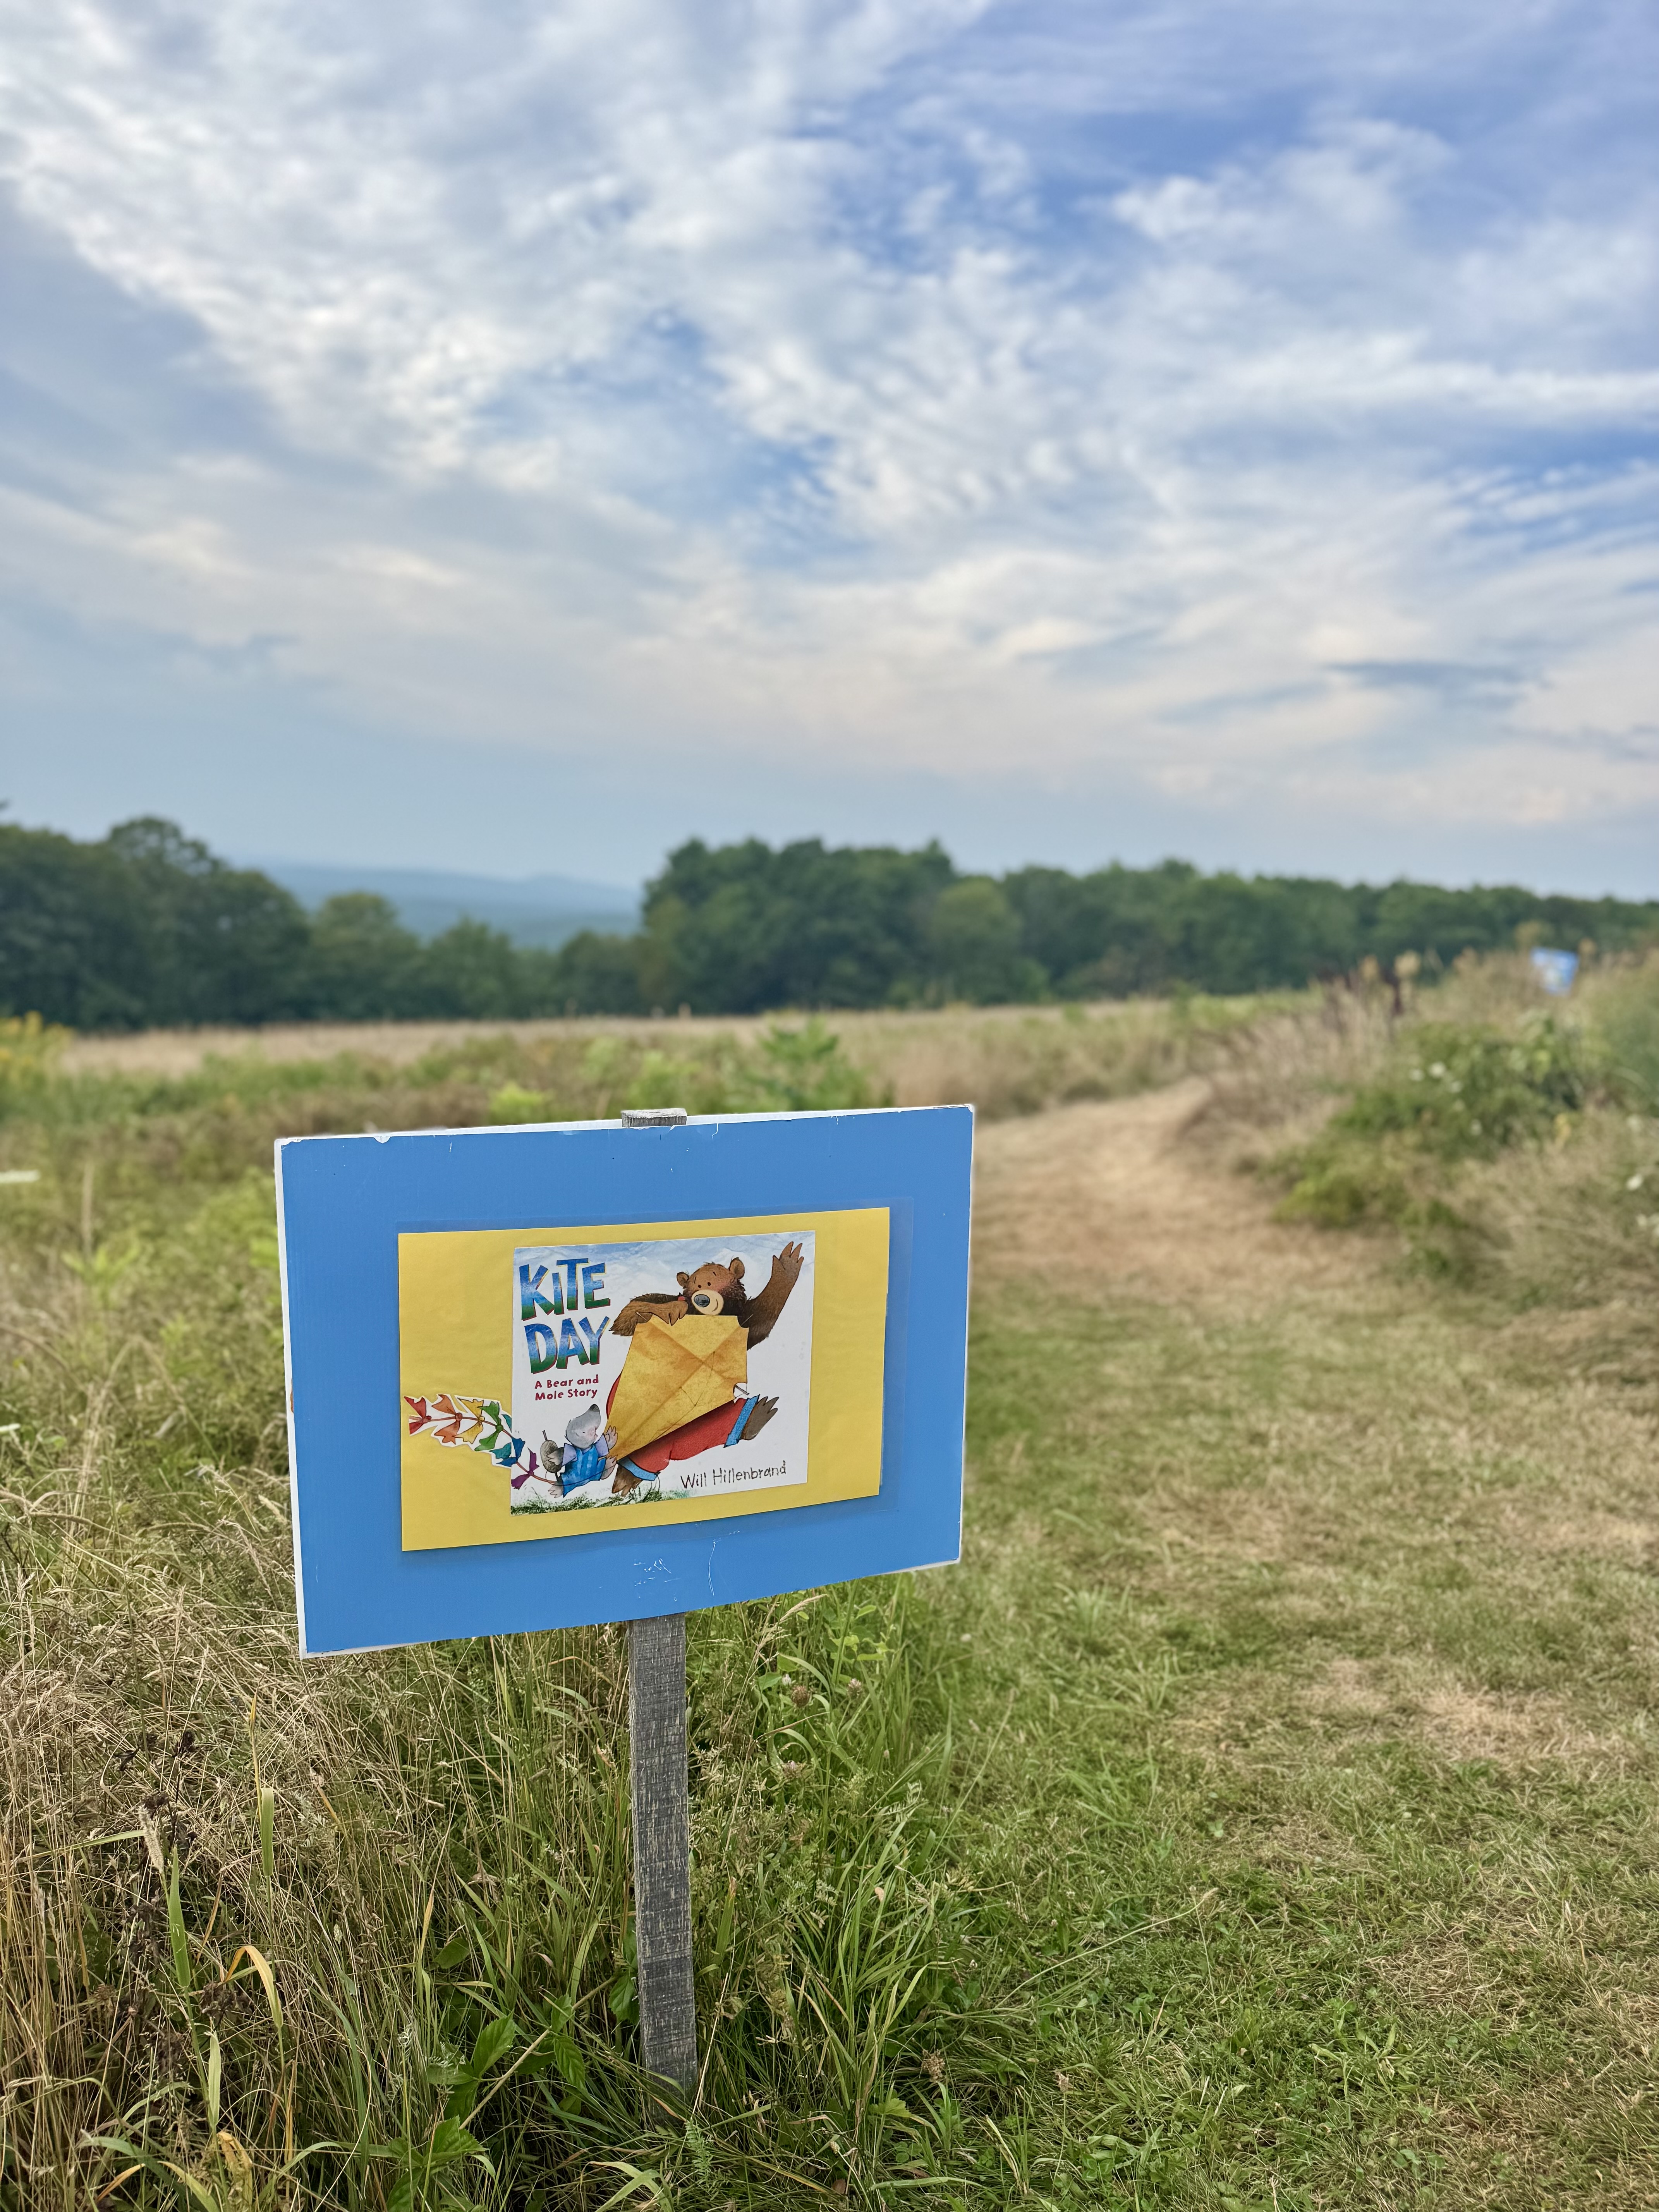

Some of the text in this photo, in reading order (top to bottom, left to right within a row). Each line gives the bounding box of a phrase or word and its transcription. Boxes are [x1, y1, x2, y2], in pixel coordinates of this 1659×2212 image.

[519, 1257, 611, 1321] KITE
[524, 1316, 611, 1374] DAY
[534, 1374, 599, 1389] A Bear and
[535, 1388, 598, 1401] Mole Story
[680, 1460, 787, 1489] Will Hillenbrand
